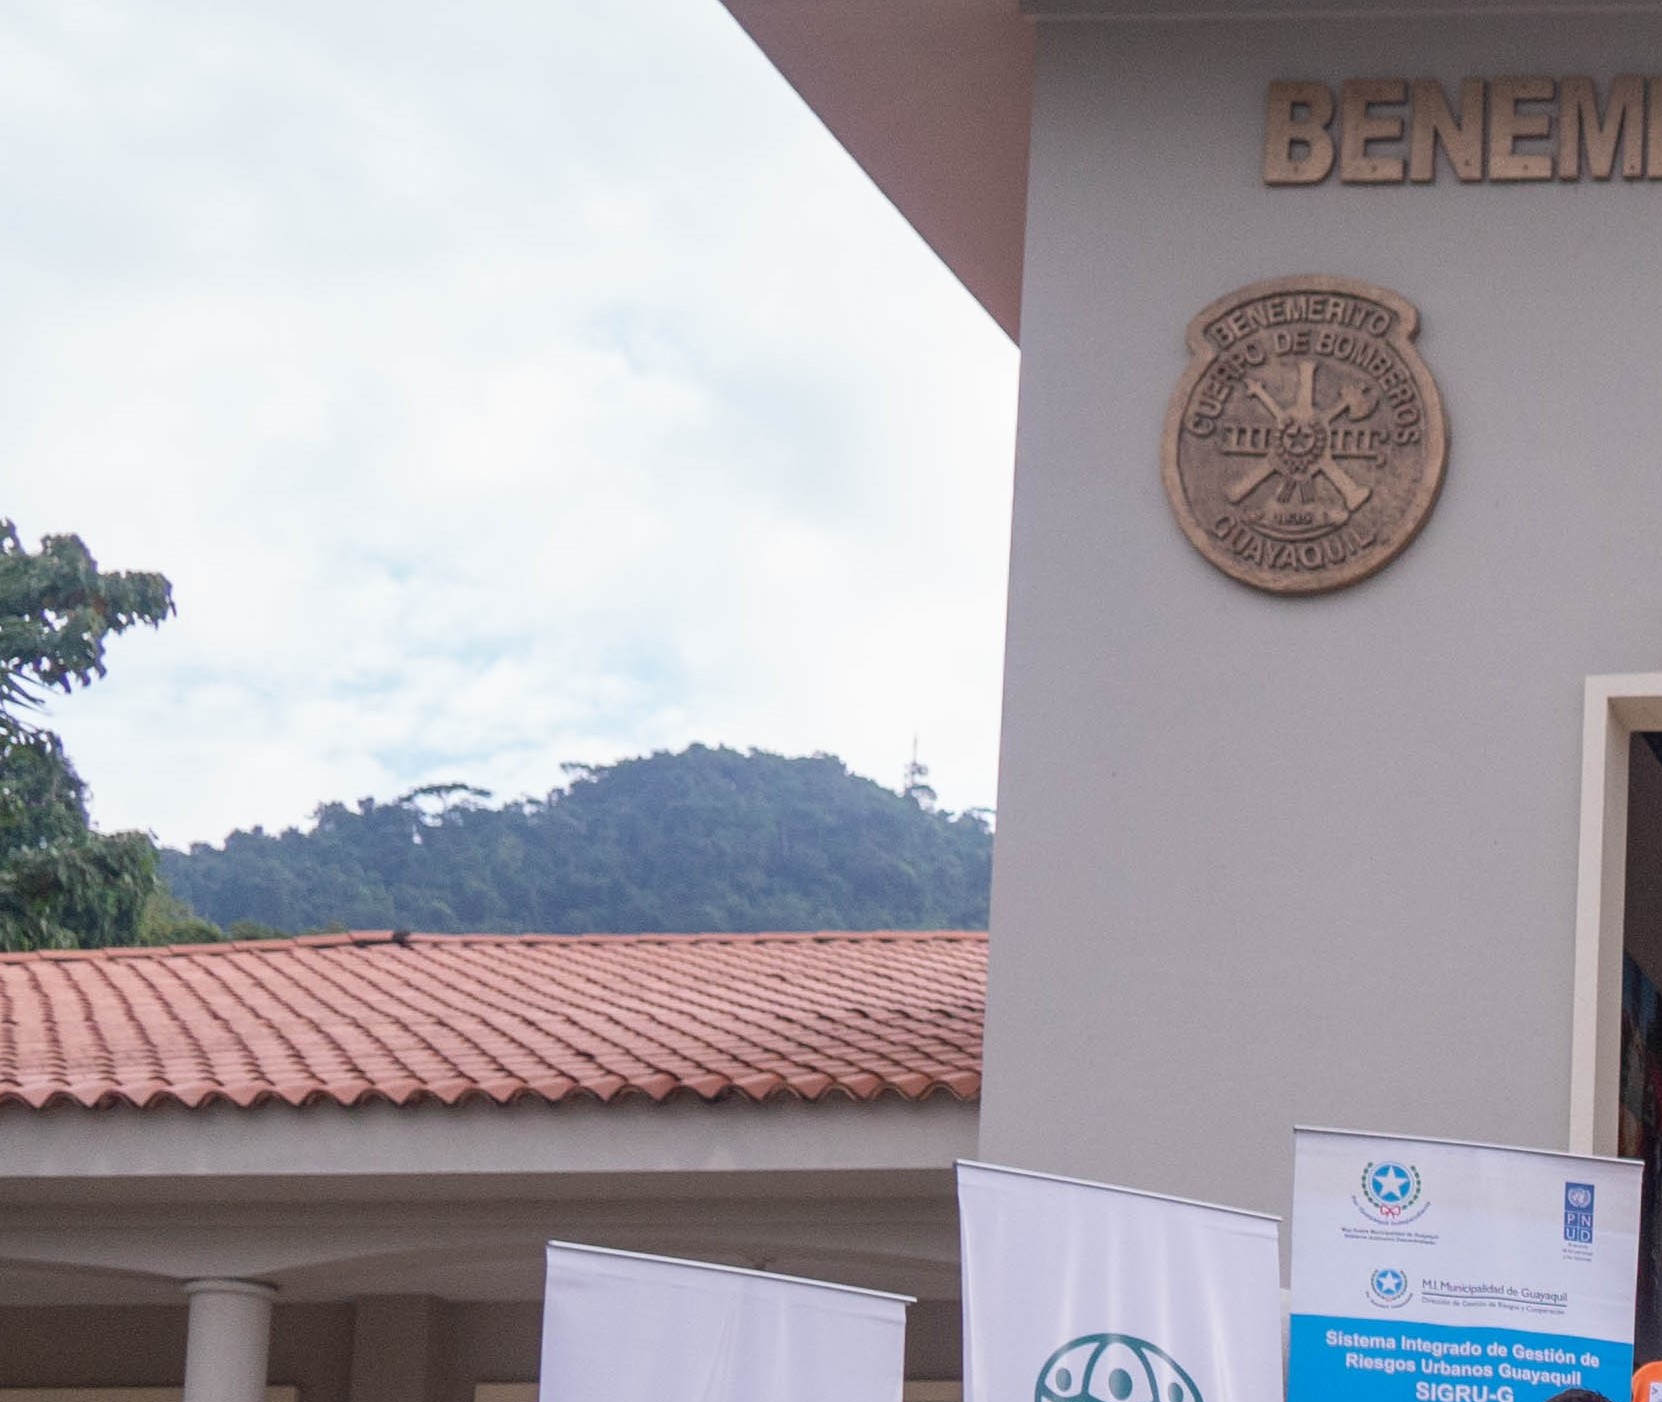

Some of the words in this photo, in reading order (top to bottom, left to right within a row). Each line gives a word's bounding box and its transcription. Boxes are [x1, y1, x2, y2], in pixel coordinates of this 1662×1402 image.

[1213, 298, 1393, 348] BENEMERITO
[1185, 341, 1266, 438] CUERPO
[1274, 331, 1311, 354] DE
[1316, 332, 1421, 446] BOMBEROS
[1212, 516, 1377, 570] GUAYAQUIL
[1440, 1281, 1504, 1295] Municipalidad
[1507, 1286, 1518, 1296] de
[1521, 1287, 1568, 1302] Guayaquil
[1326, 1330, 1396, 1351] Sistema
[1401, 1334, 1482, 1358] Integrado
[1487, 1339, 1508, 1357] de
[1512, 1343, 1576, 1365] Gestión
[1580, 1350, 1600, 1367] de
[1345, 1353, 1417, 1375] Riesgos
[1421, 1359, 1493, 1378] Urbanos
[1499, 1364, 1581, 1386] Guayaquil
